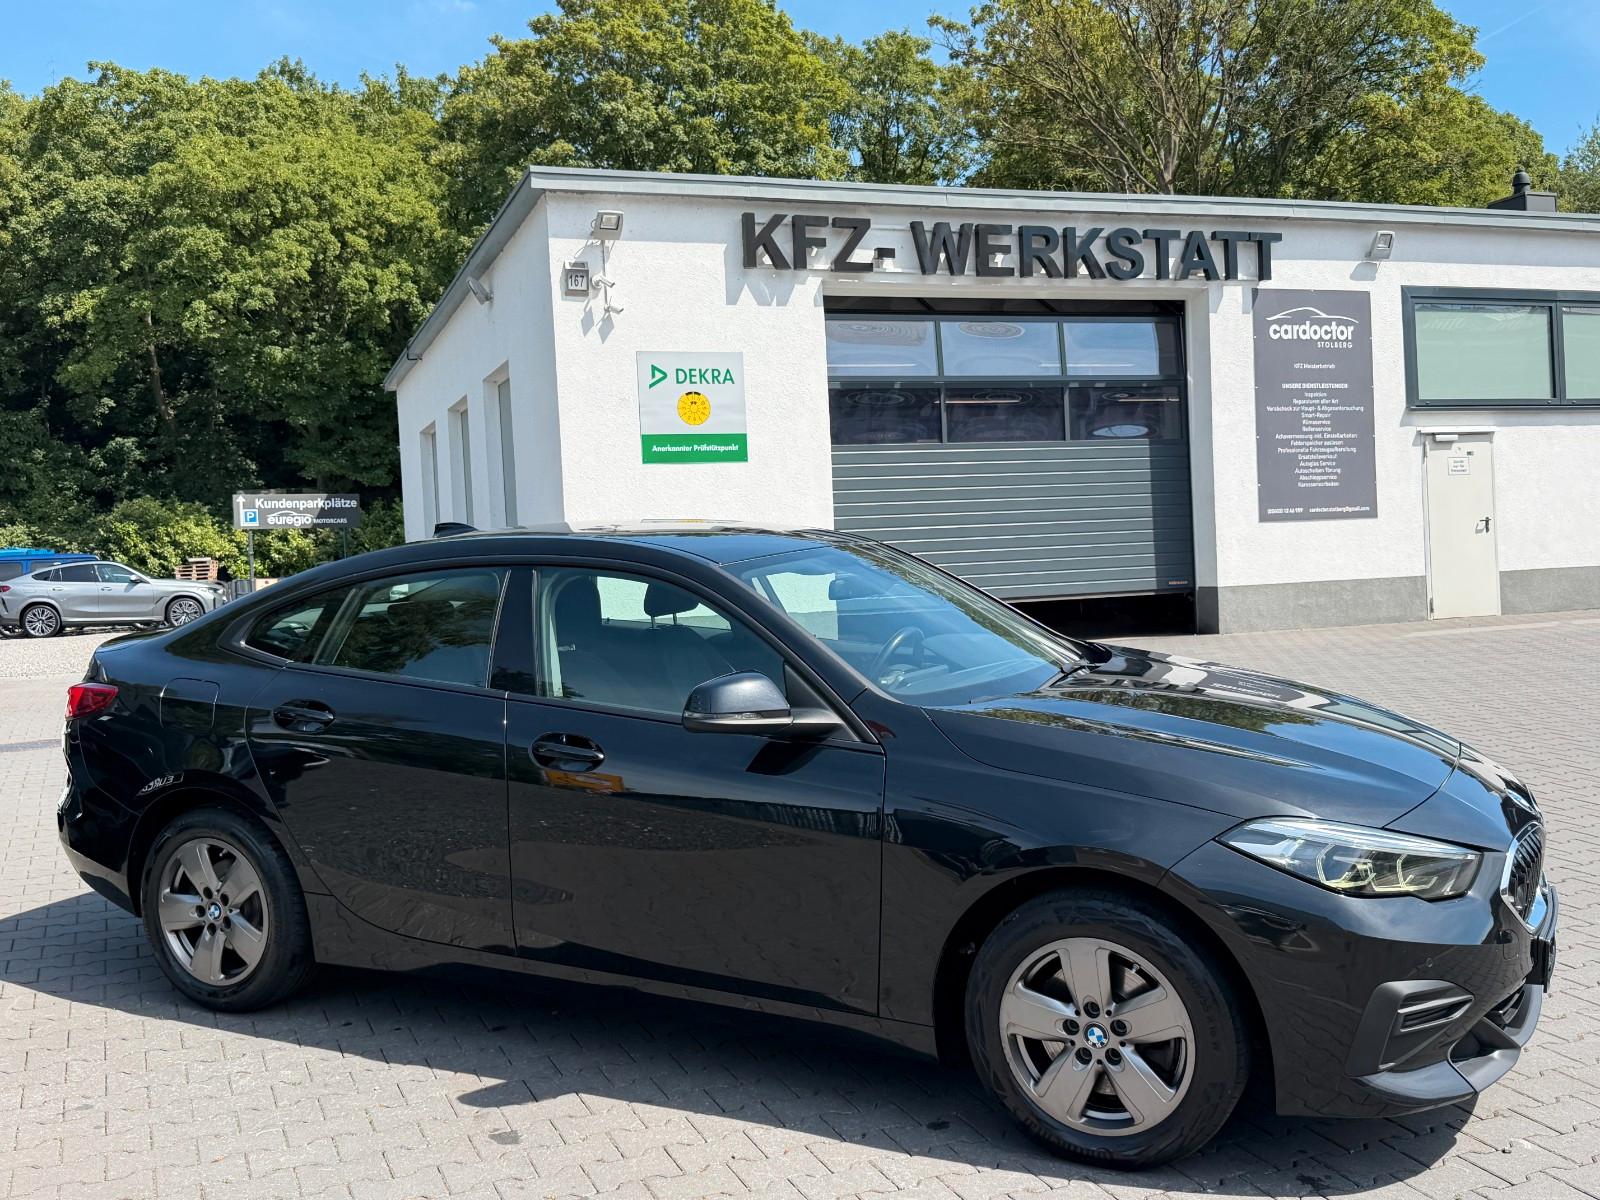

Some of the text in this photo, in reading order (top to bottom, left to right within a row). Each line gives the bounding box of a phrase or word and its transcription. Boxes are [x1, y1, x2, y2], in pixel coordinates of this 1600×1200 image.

[742, 212, 1282, 280] KFZ- WERKSTATT
[569, 274, 585, 288] 167
[1269, 320, 1354, 340] cardoctor
[1317, 341, 1353, 349] STOLBERG
[675, 368, 735, 385] DEKRA
[651, 443, 739, 453] Anerkannter Prüfstützpunkt
[255, 498, 357, 510] Kundenparkplätze
[246, 511, 255, 522] P
[267, 515, 312, 527] euregio
